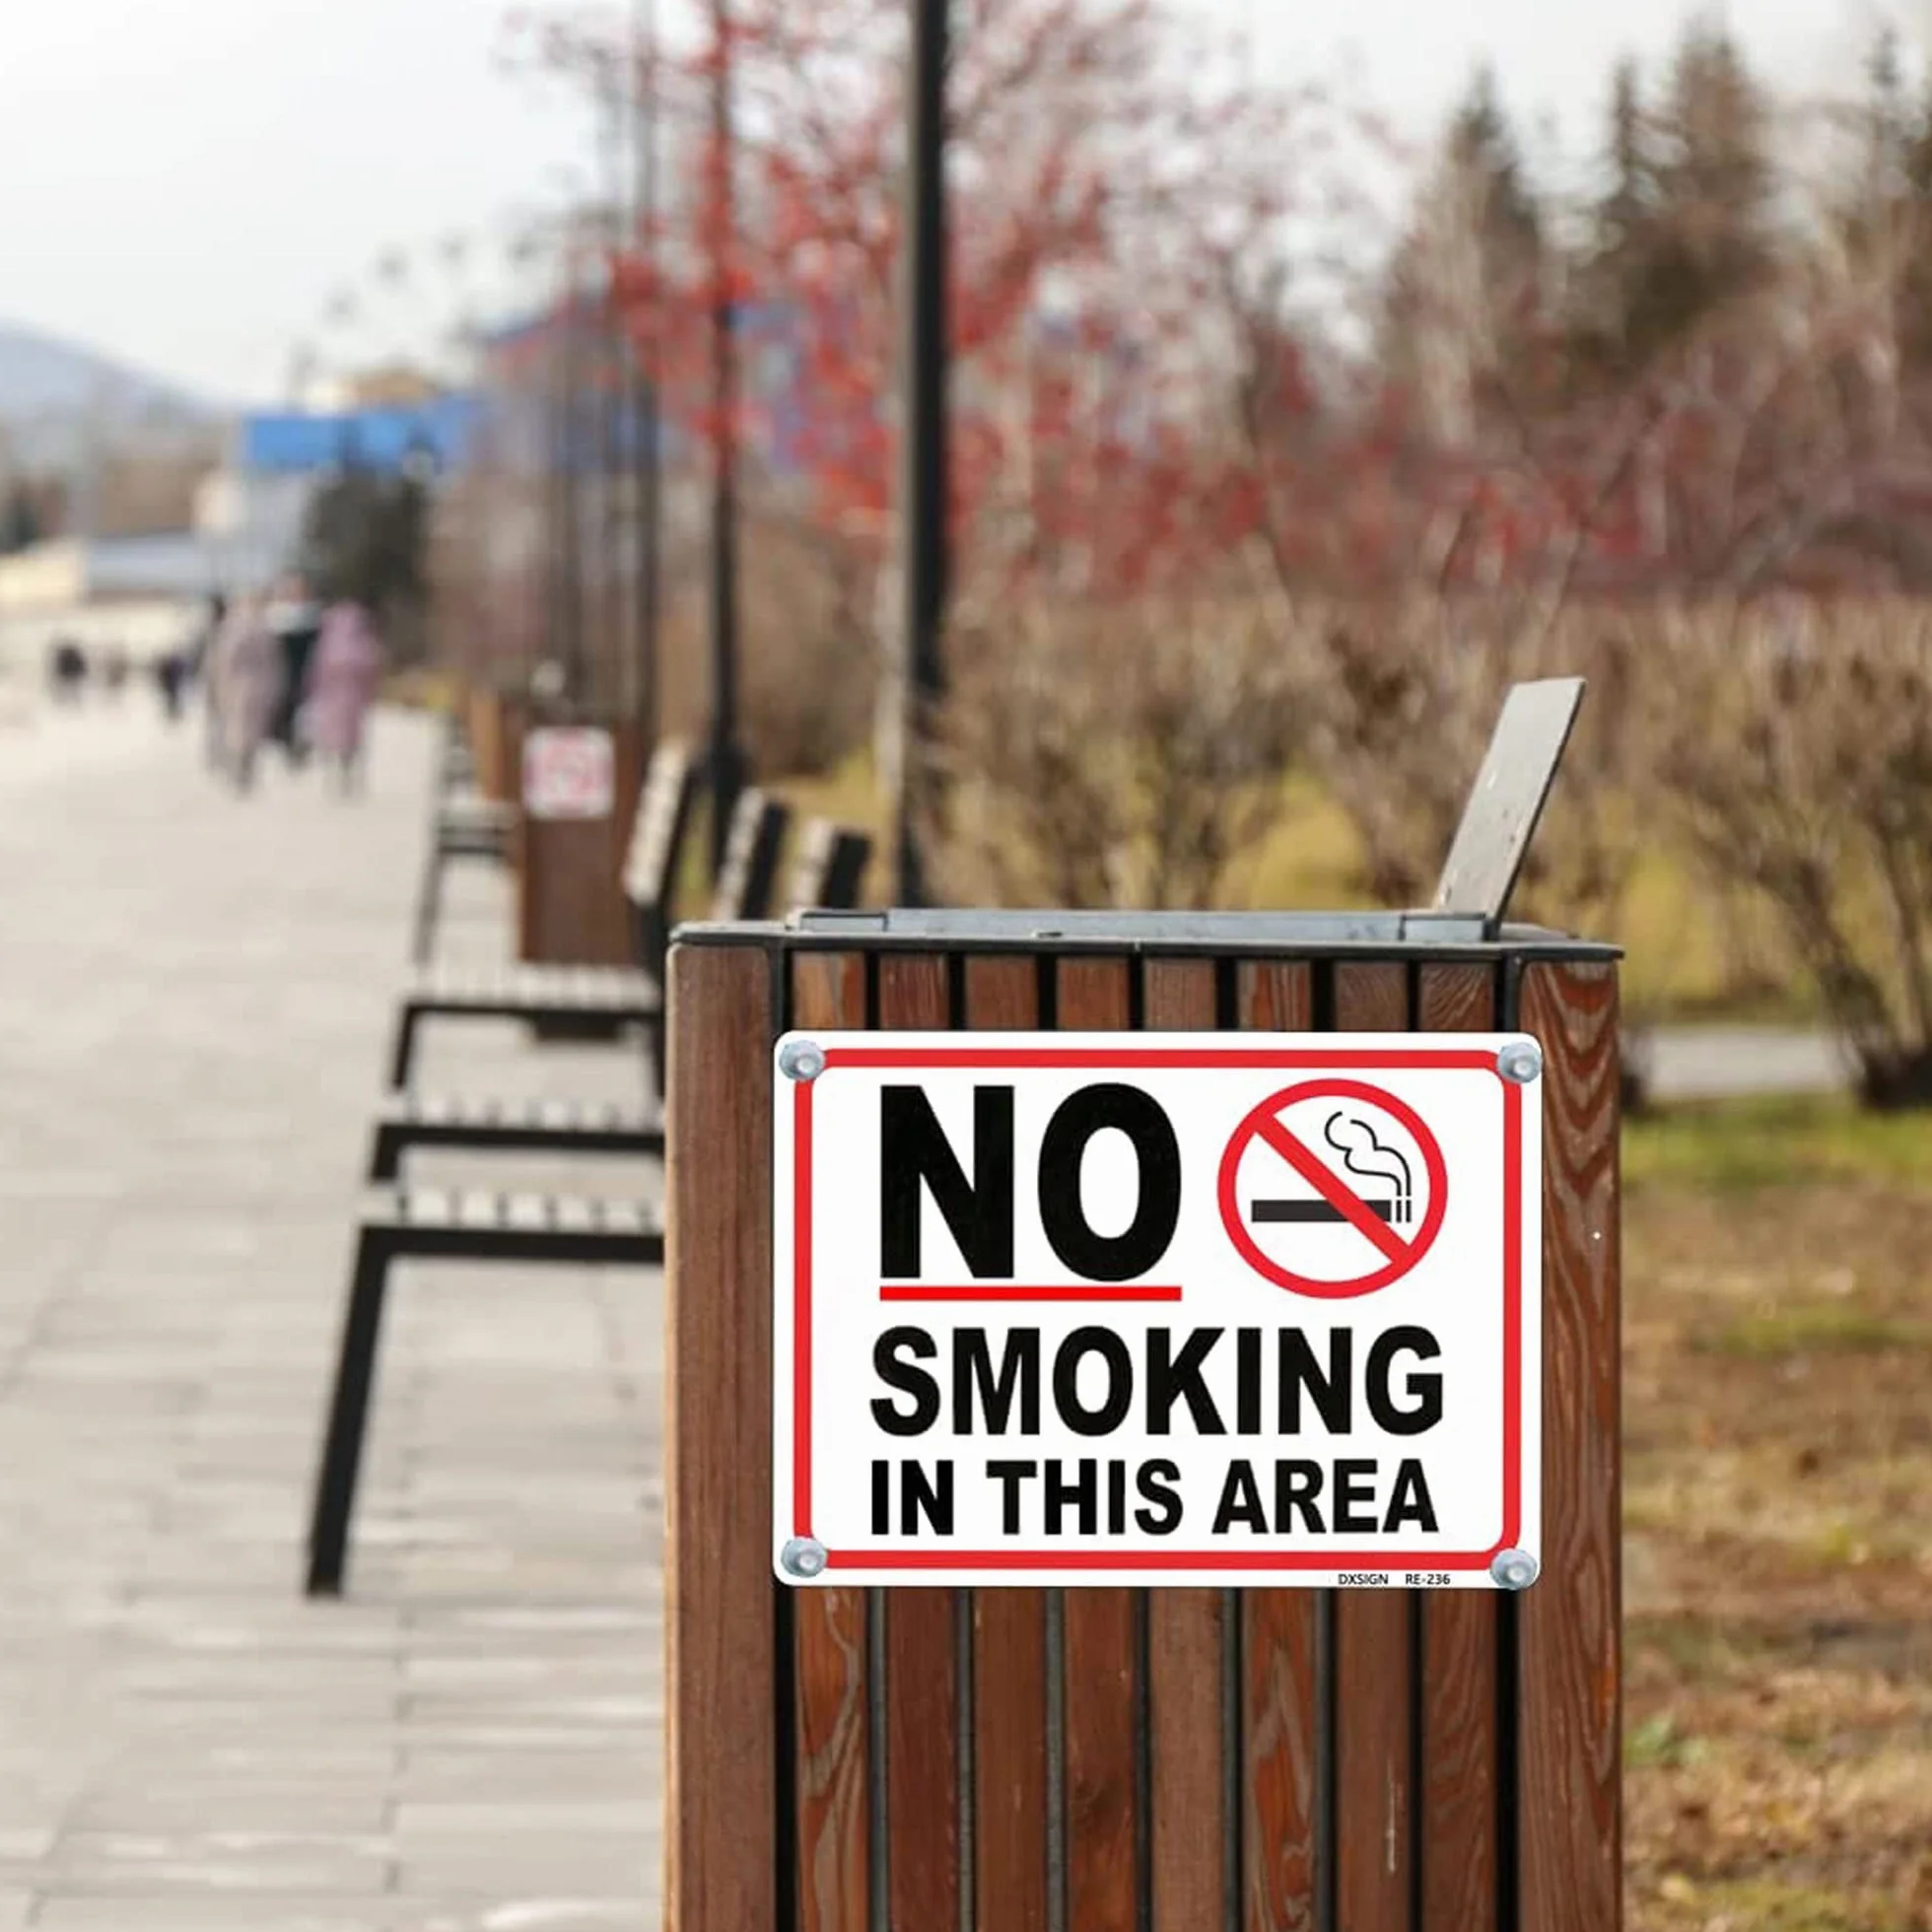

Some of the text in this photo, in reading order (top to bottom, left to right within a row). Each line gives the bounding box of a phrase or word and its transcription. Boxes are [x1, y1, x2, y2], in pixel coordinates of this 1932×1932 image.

[880, 1082, 1182, 1282] NO
[870, 1326, 1443, 1437] SMOKING
[871, 1459, 1439, 1536] IN THIS AREA
[1338, 1573, 1451, 1585] DXSIGN RE-236
